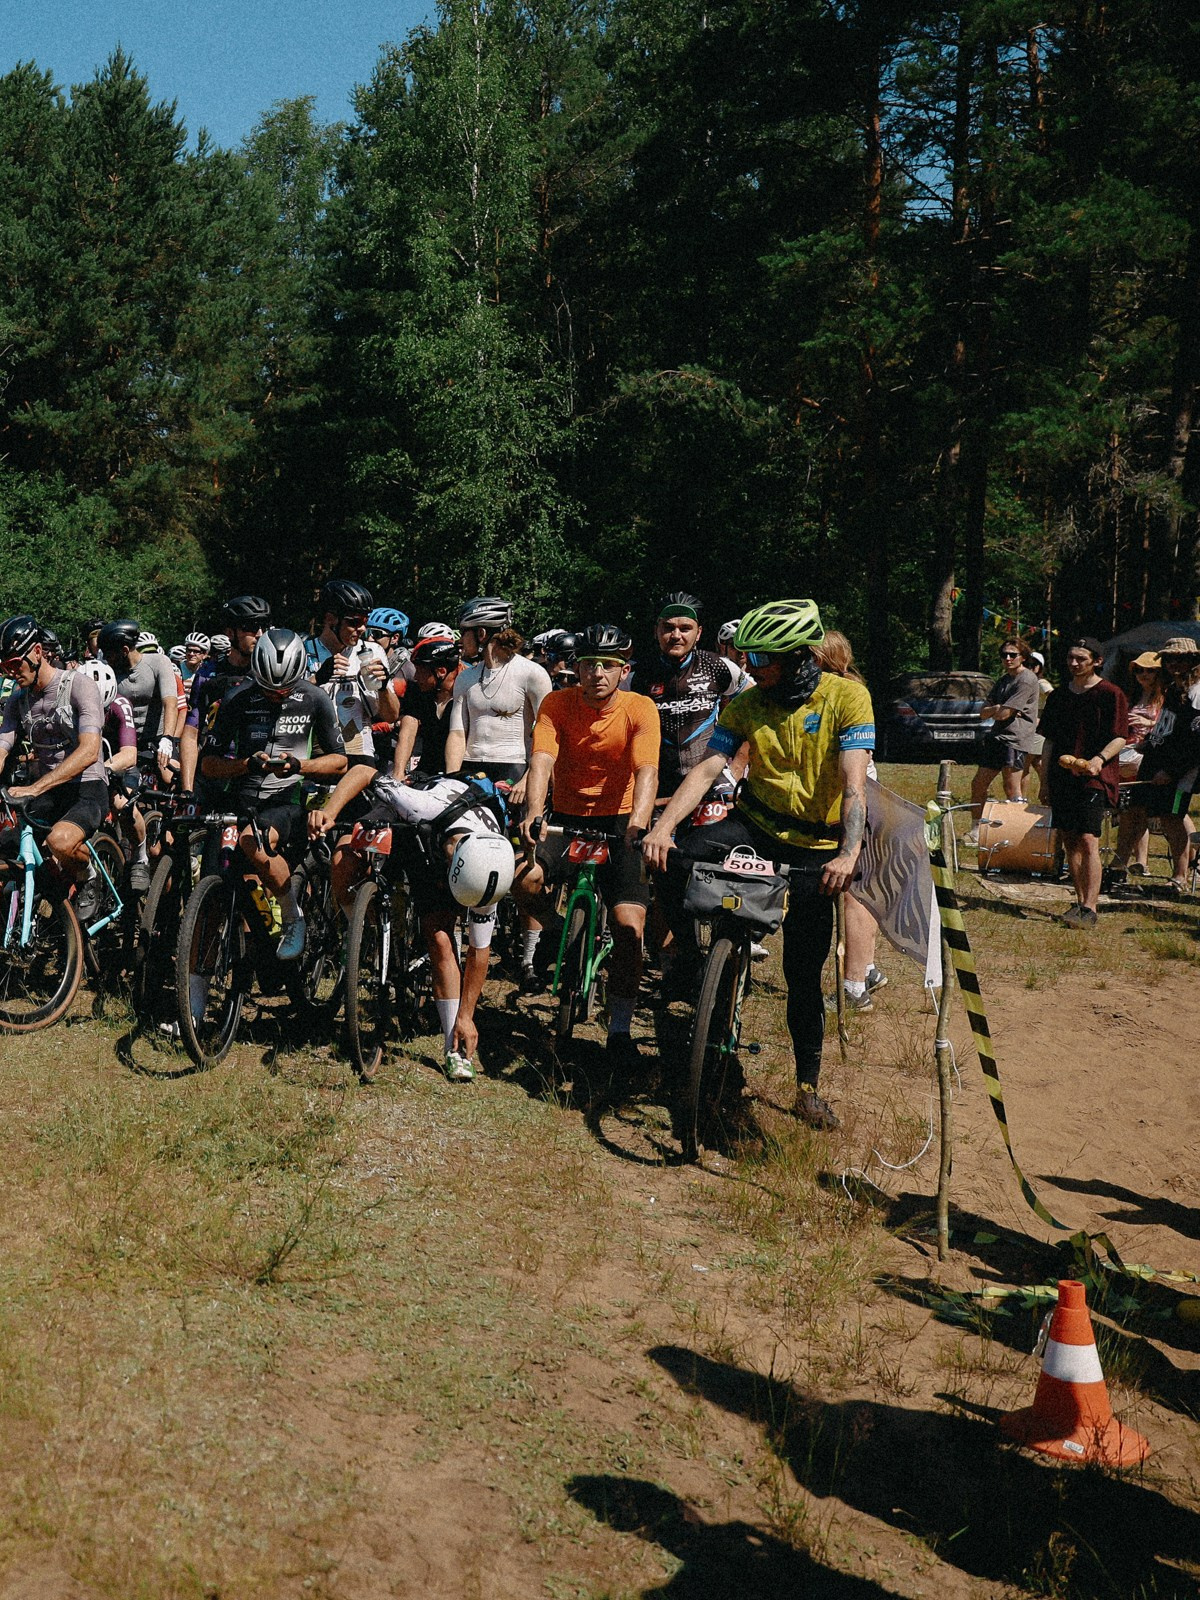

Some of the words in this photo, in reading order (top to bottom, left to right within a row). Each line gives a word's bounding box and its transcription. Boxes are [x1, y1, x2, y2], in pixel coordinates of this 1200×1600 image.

[670, 701, 714, 715] SPORT
[278, 715, 311, 724] SKOOL
[278, 724, 306, 734] SUX
[697, 803, 723, 817] 730
[575, 841, 603, 857] 712
[451, 857, 465, 884] POC
[730, 860, 766, 872] 509
